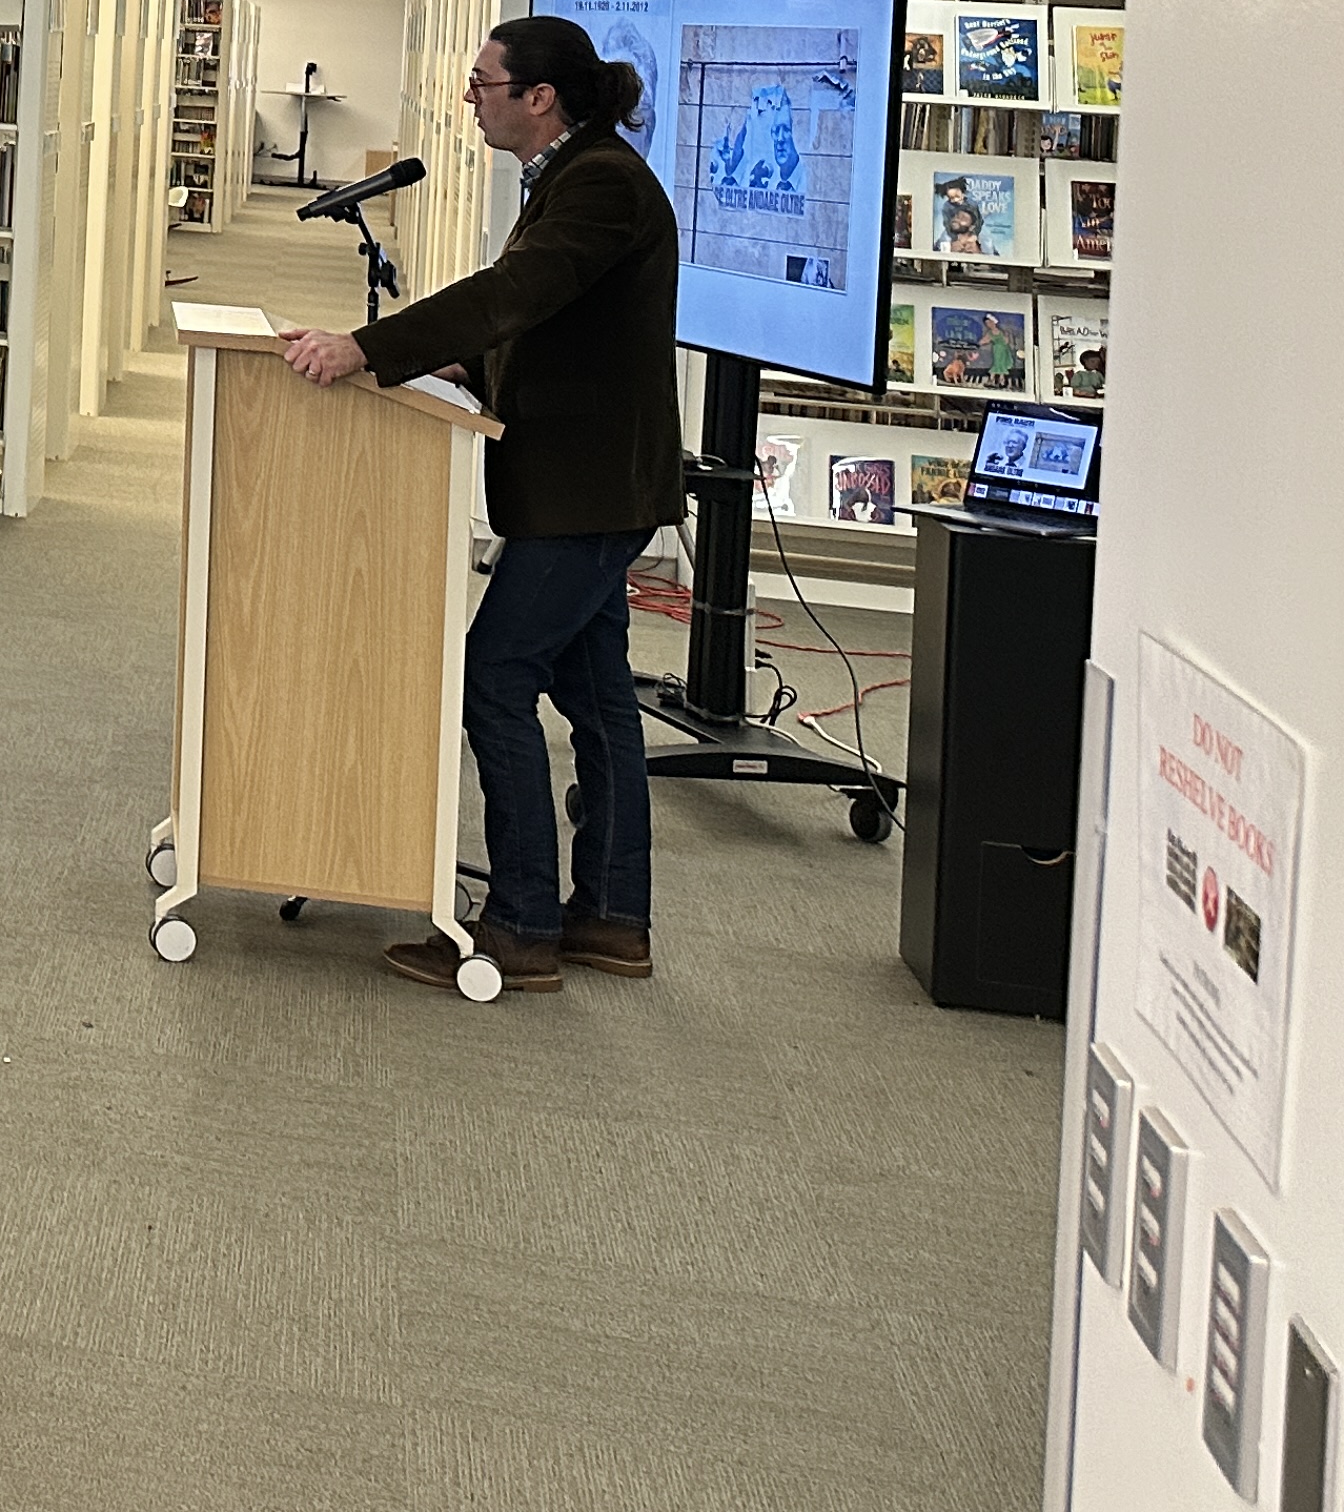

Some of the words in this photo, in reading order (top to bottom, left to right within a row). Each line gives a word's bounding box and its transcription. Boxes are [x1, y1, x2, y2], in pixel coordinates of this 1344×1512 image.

[965, 178, 1002, 191] DADDY
[972, 190, 1011, 202] SPEAKS
[982, 201, 1008, 216] LOVE
[1194, 713, 1212, 755] DO
[1215, 731, 1243, 781] NOT
[1159, 745, 1225, 830] RESHELVE
[1227, 804, 1275, 877] BOOKS
